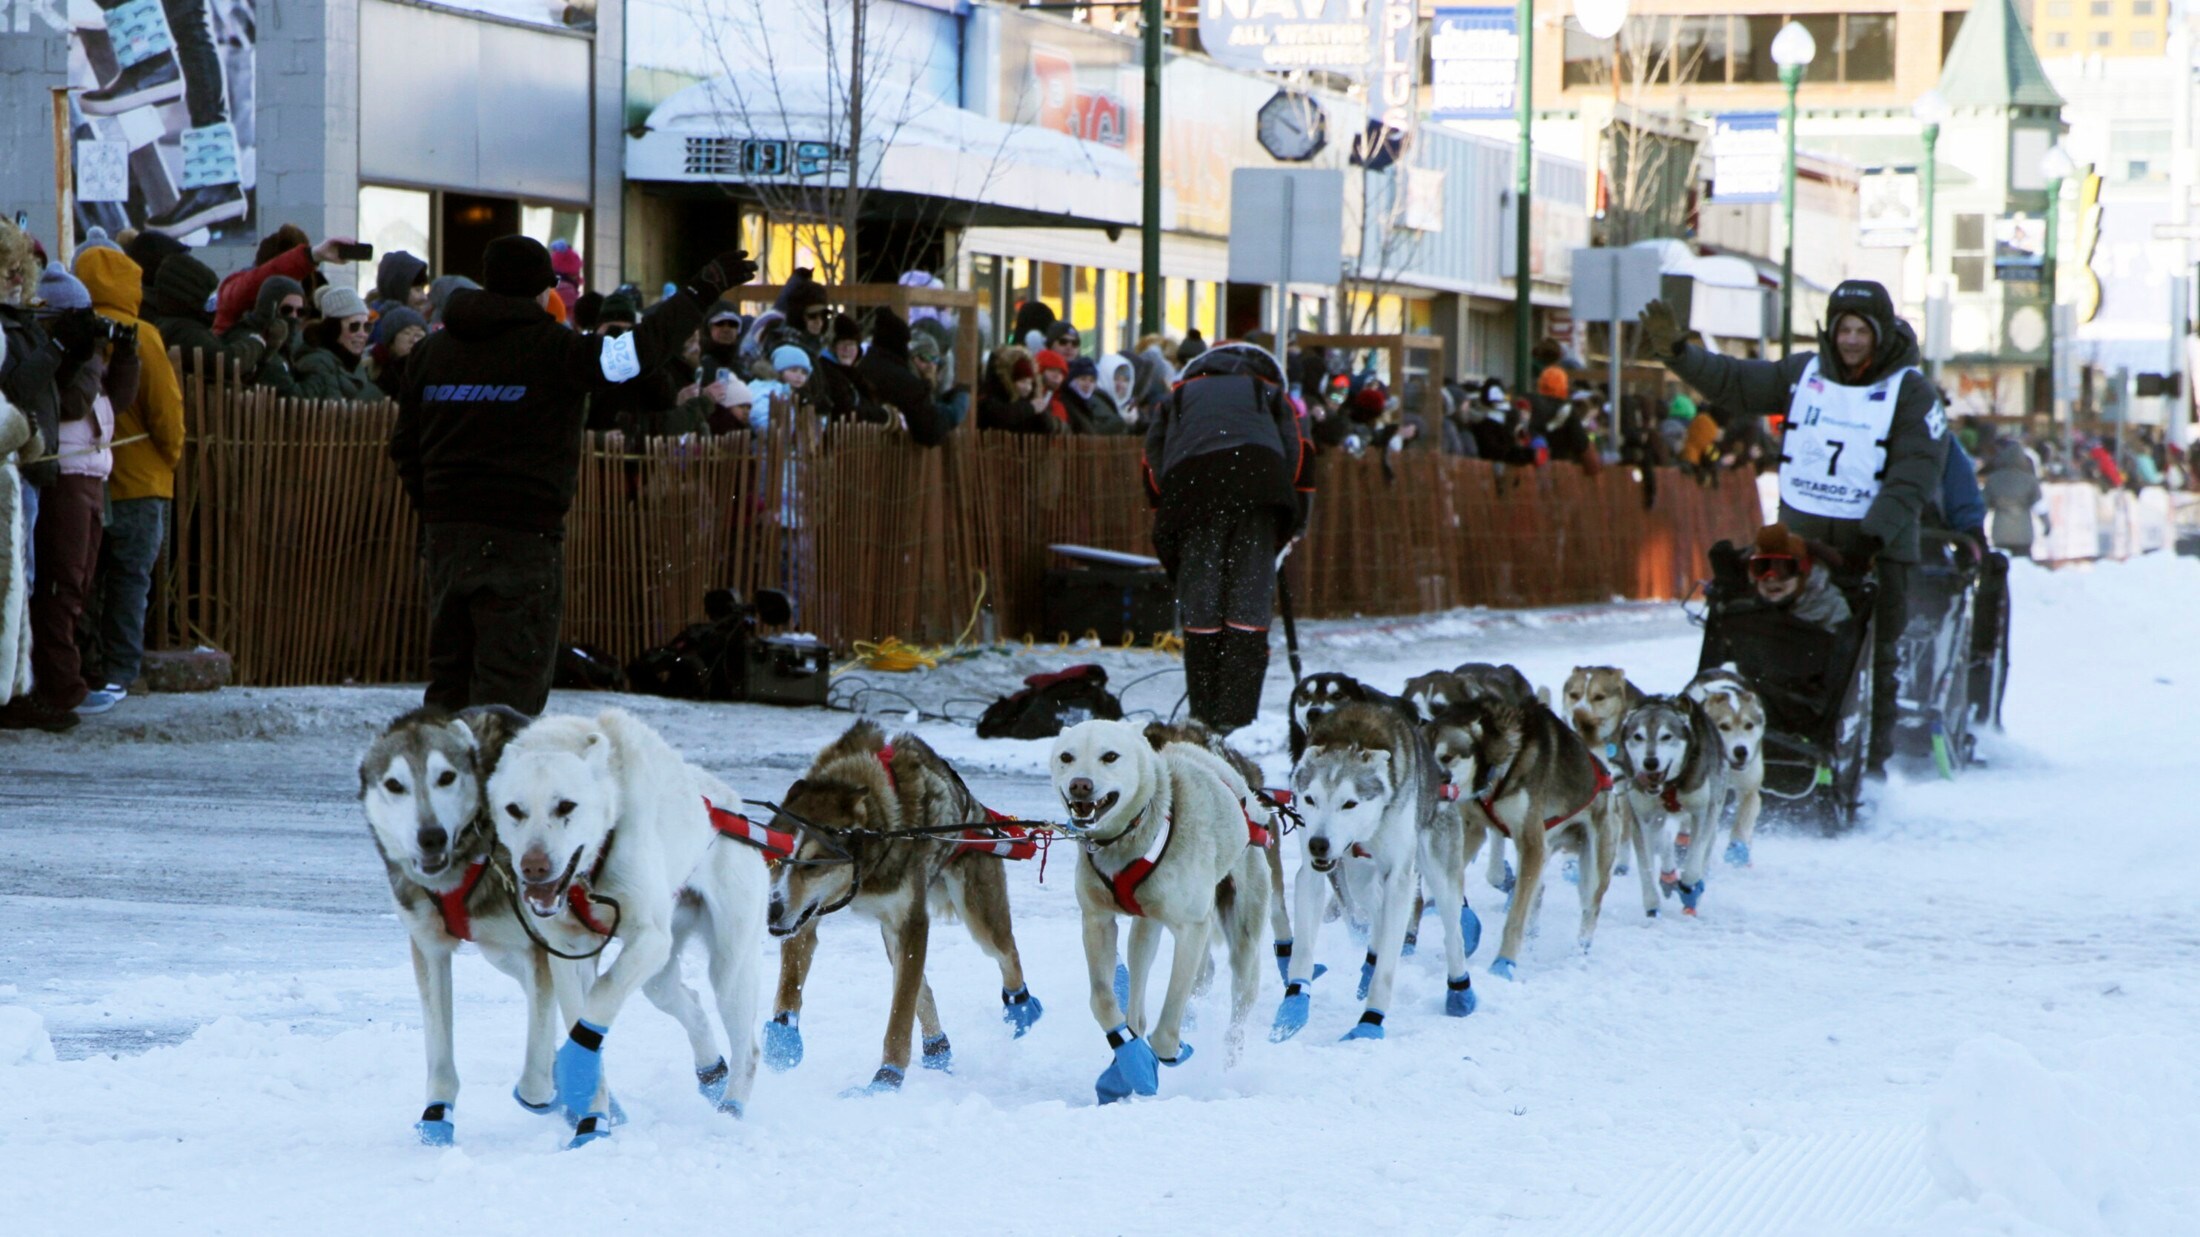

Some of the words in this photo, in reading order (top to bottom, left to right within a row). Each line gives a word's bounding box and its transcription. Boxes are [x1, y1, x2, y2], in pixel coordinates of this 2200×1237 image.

[1228, 24, 1271, 46] ALL
[422, 384, 527, 401] BOEING
[1826, 439, 1845, 477] 7
